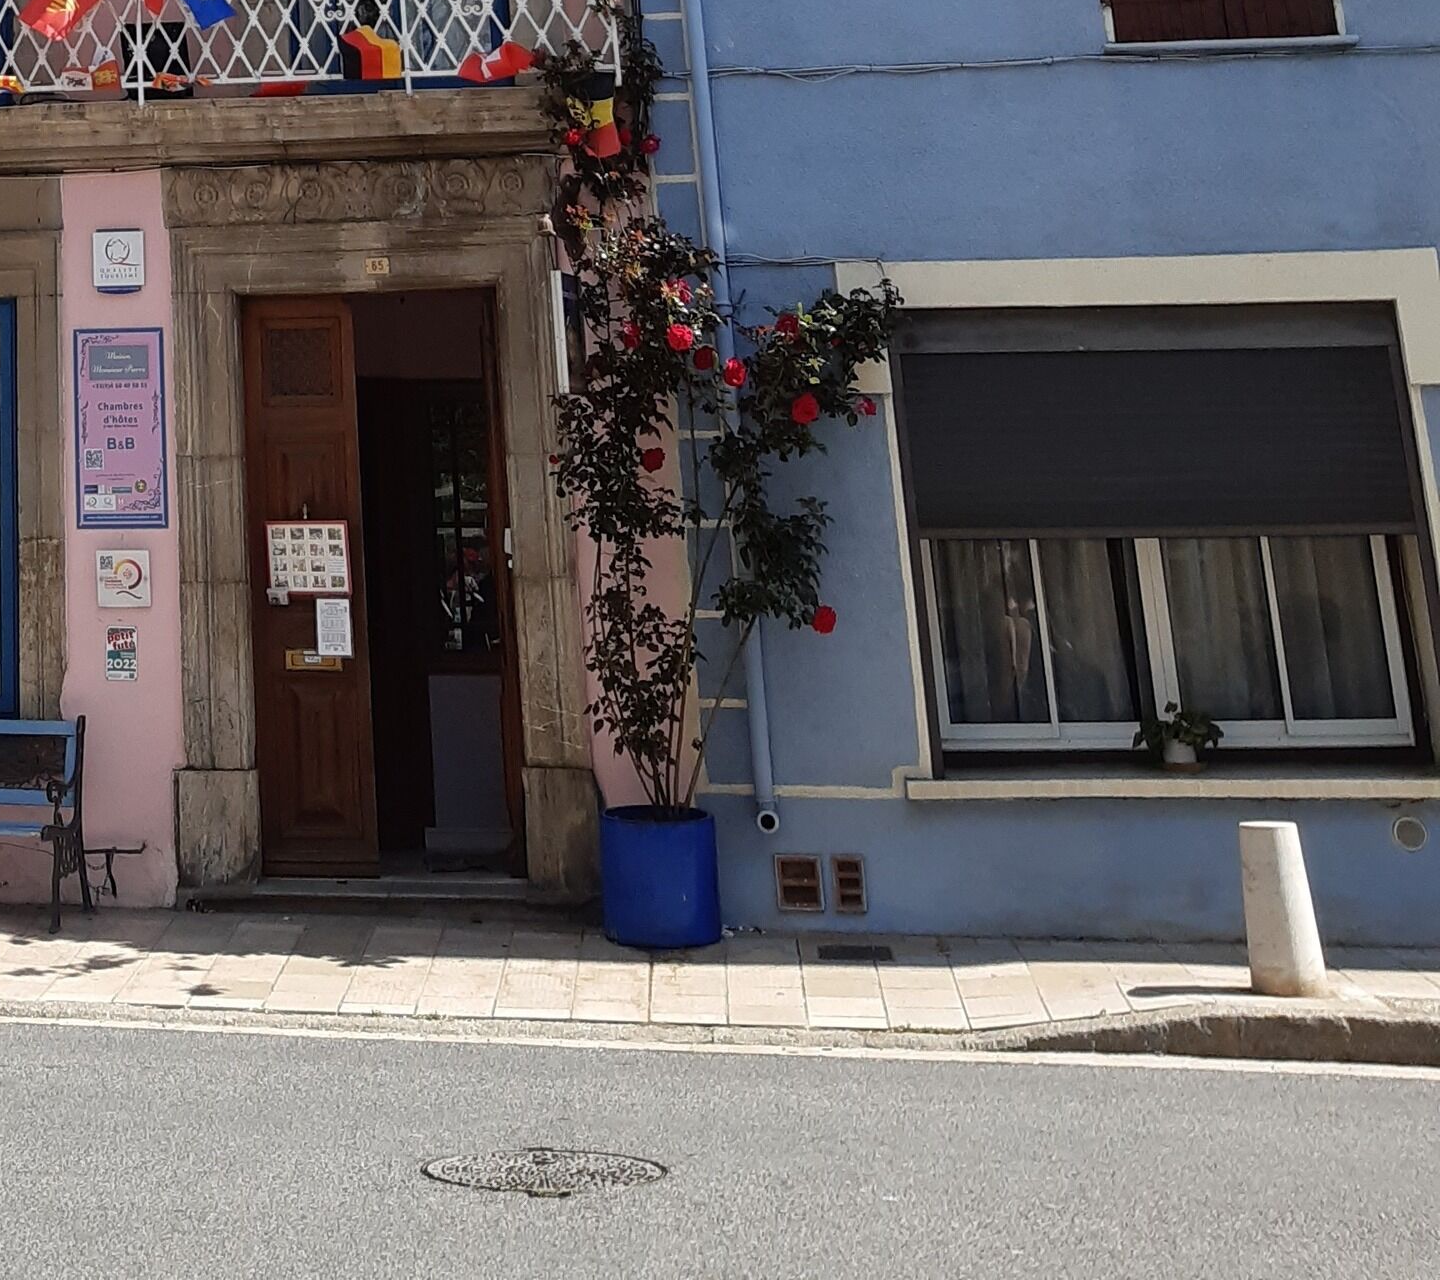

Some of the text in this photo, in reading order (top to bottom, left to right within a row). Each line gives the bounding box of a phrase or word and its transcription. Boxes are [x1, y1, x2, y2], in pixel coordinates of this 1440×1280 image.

[371, 260, 384, 271] 65
[98, 402, 143, 411] Chambres
[103, 414, 138, 424] d'hôtes
[107, 437, 135, 450] B&B
[107, 630, 133, 644] petit
[107, 658, 136, 669] 2022
